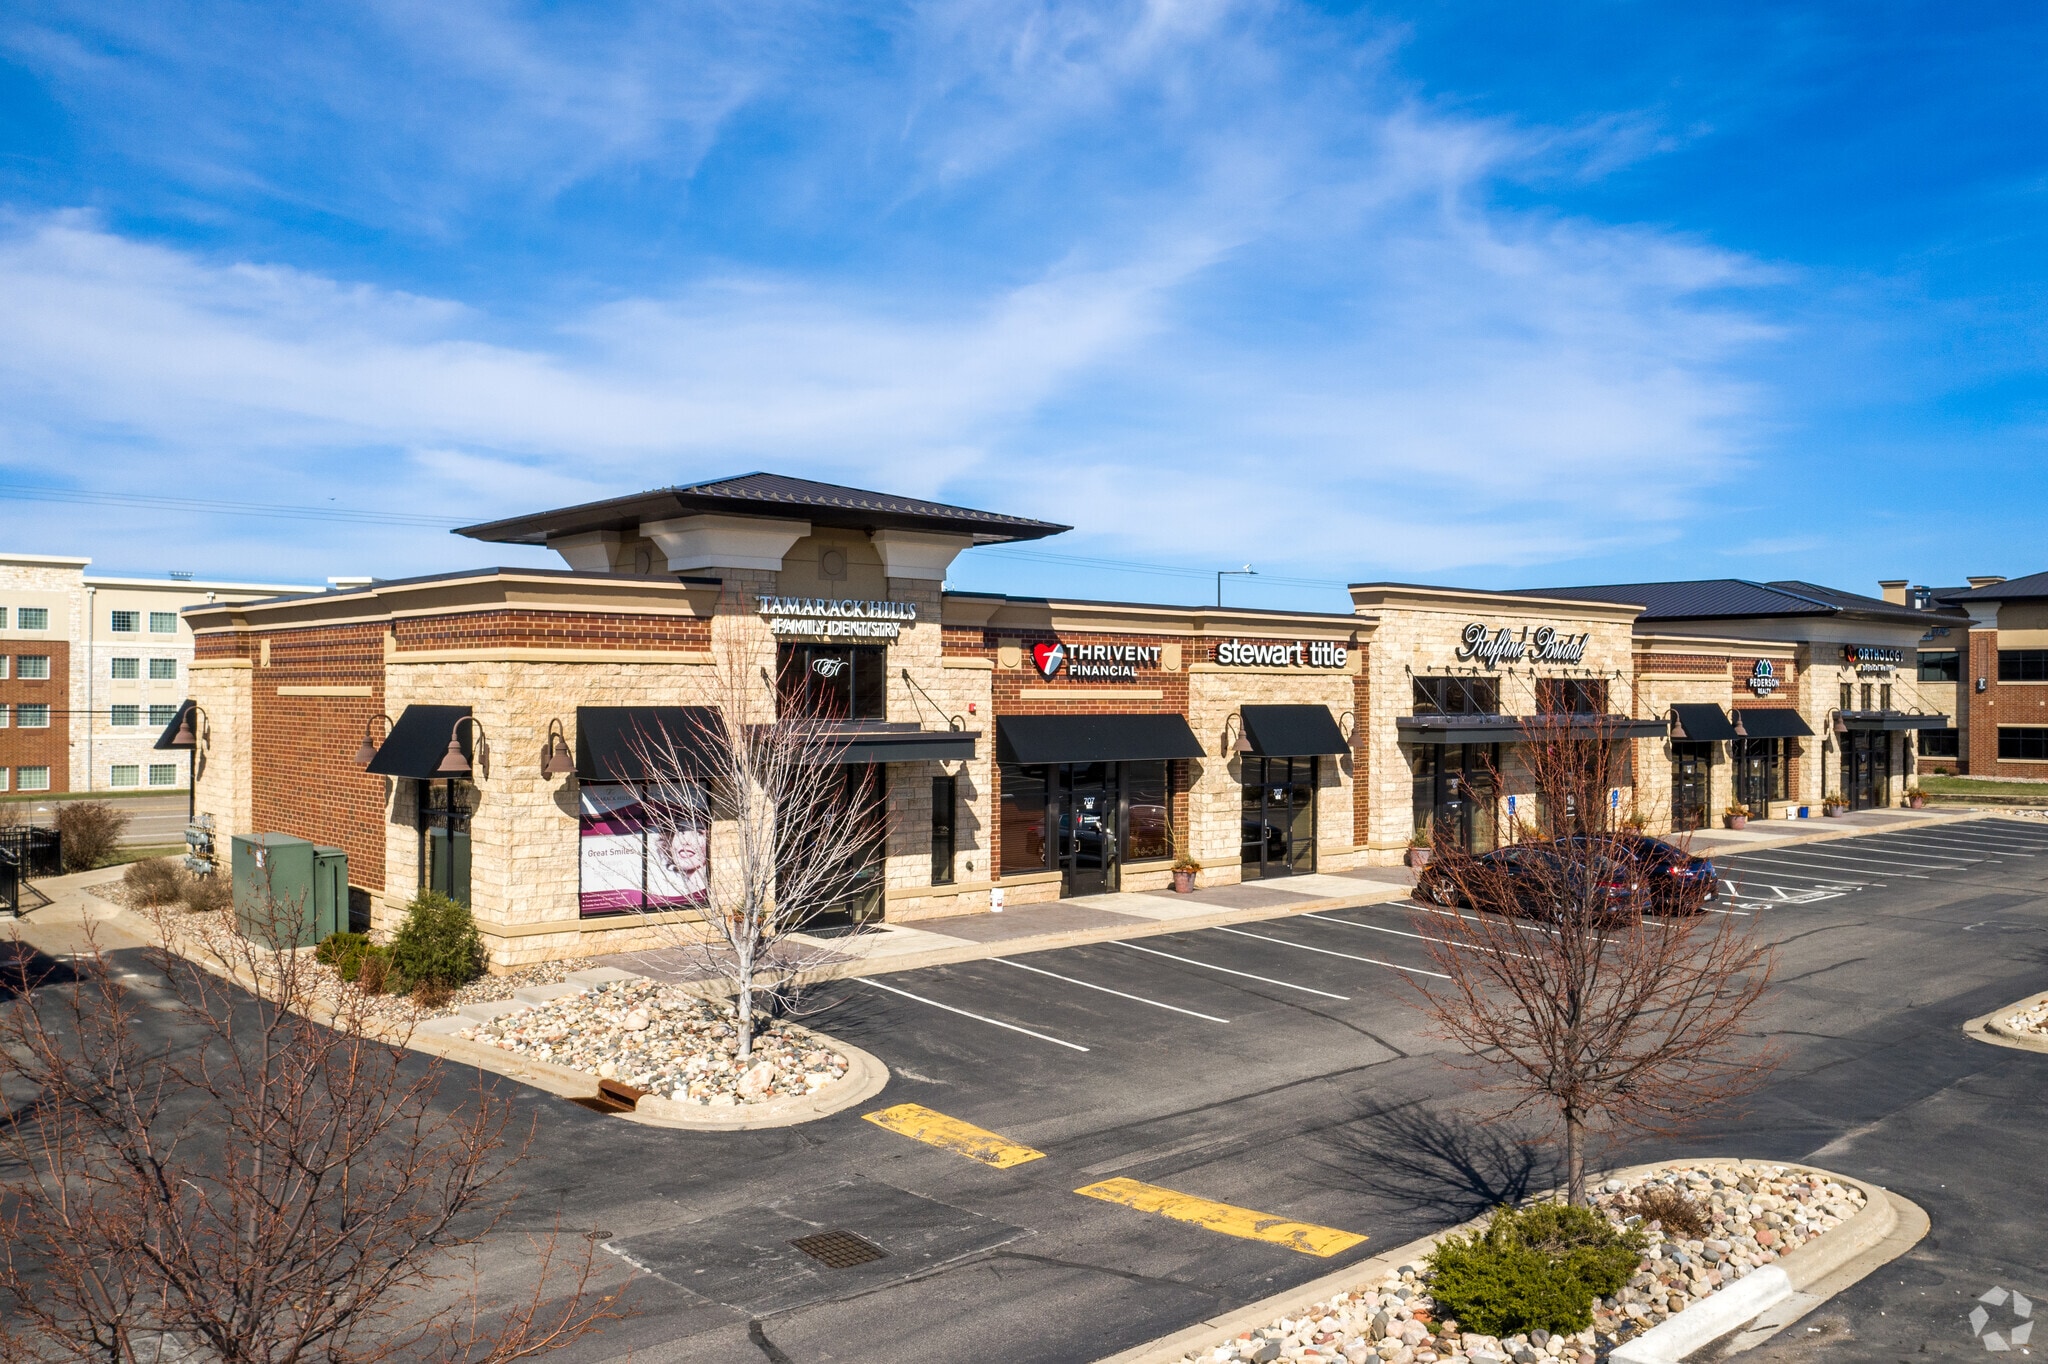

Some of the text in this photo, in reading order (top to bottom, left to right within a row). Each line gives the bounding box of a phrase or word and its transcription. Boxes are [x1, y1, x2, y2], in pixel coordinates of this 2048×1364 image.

[759, 595, 917, 620] TAMARACK HILLS
[773, 618, 900, 637] FAMILY DENTISTRY
[1531, 625, 1590, 661] Bridal
[1065, 644, 1162, 661] THRIVENT
[1218, 639, 1347, 667] stewart title
[1858, 648, 1905, 662] ORTHOLOGY
[1070, 665, 1138, 676] FINANCIAL
[1750, 678, 1780, 687] PEDERSON
[588, 850, 608, 858] Great
